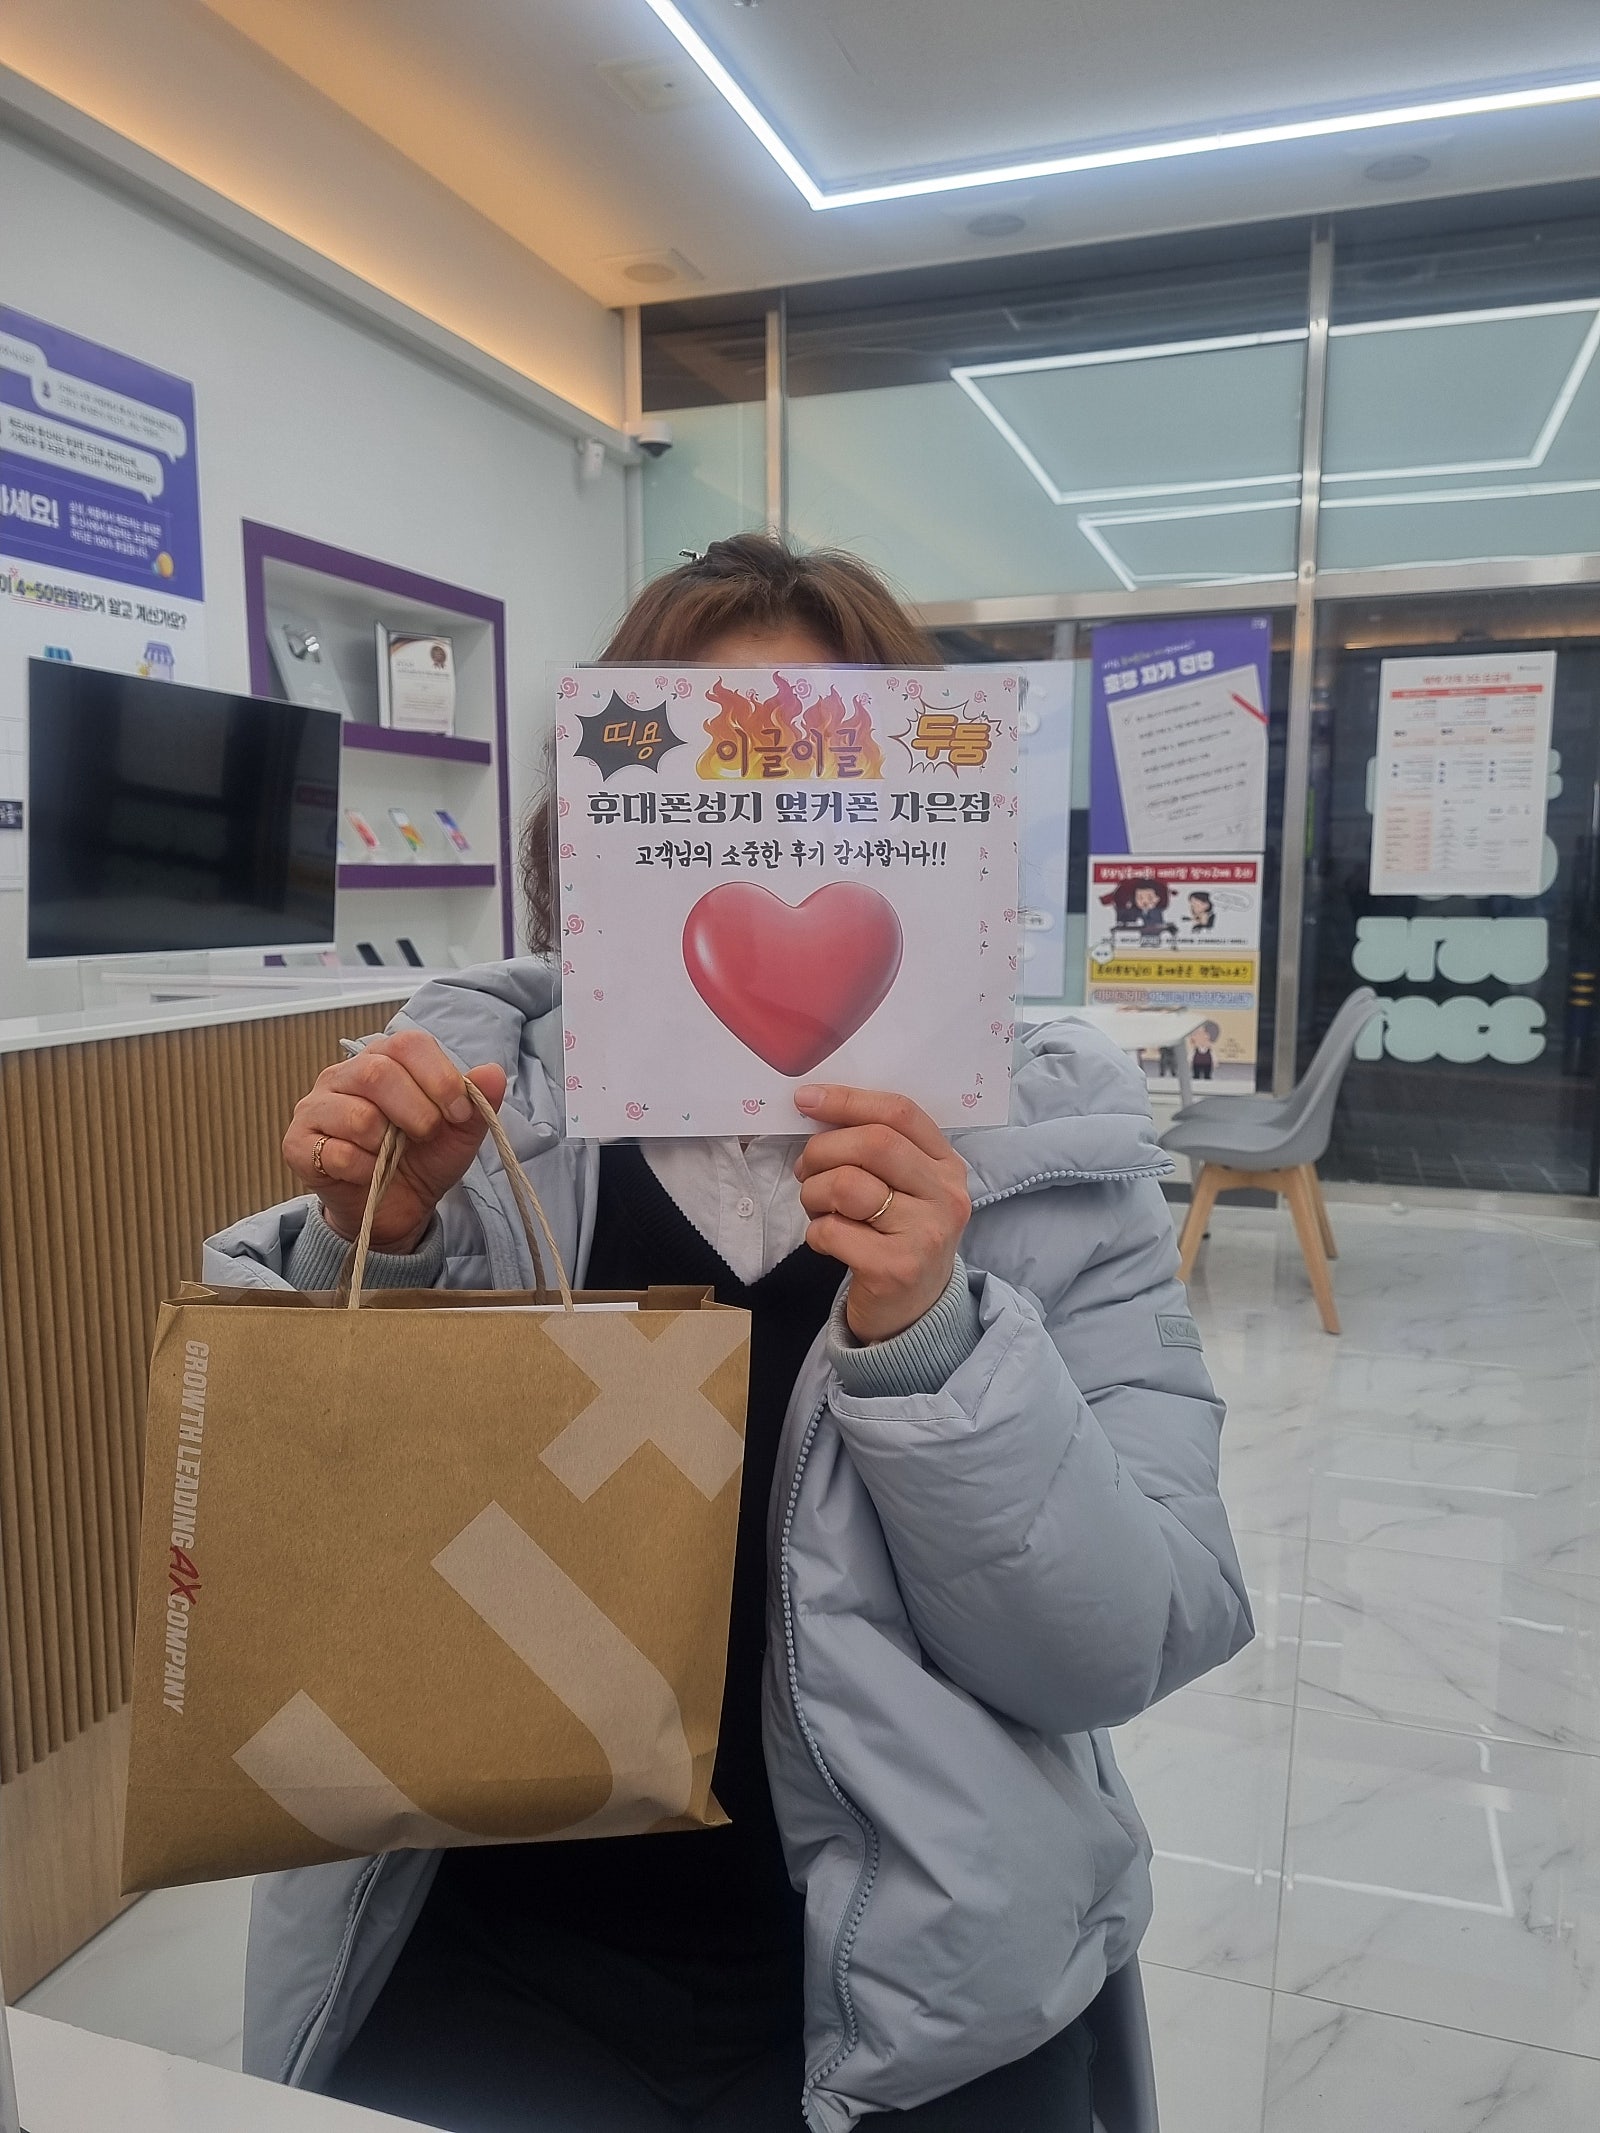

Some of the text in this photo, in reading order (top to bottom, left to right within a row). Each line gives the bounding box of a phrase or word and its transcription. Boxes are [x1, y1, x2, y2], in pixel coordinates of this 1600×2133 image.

[602, 713, 993, 779] 띠용 이글이글 두둥
[586, 790, 992, 825] 휴대폰성지 옆커폰 자은점
[635, 839, 948, 869] 고객님의 소중한 후기 감사합니다!!
[163, 1340, 209, 1716] GROWTH LEADING AX COMPANY
